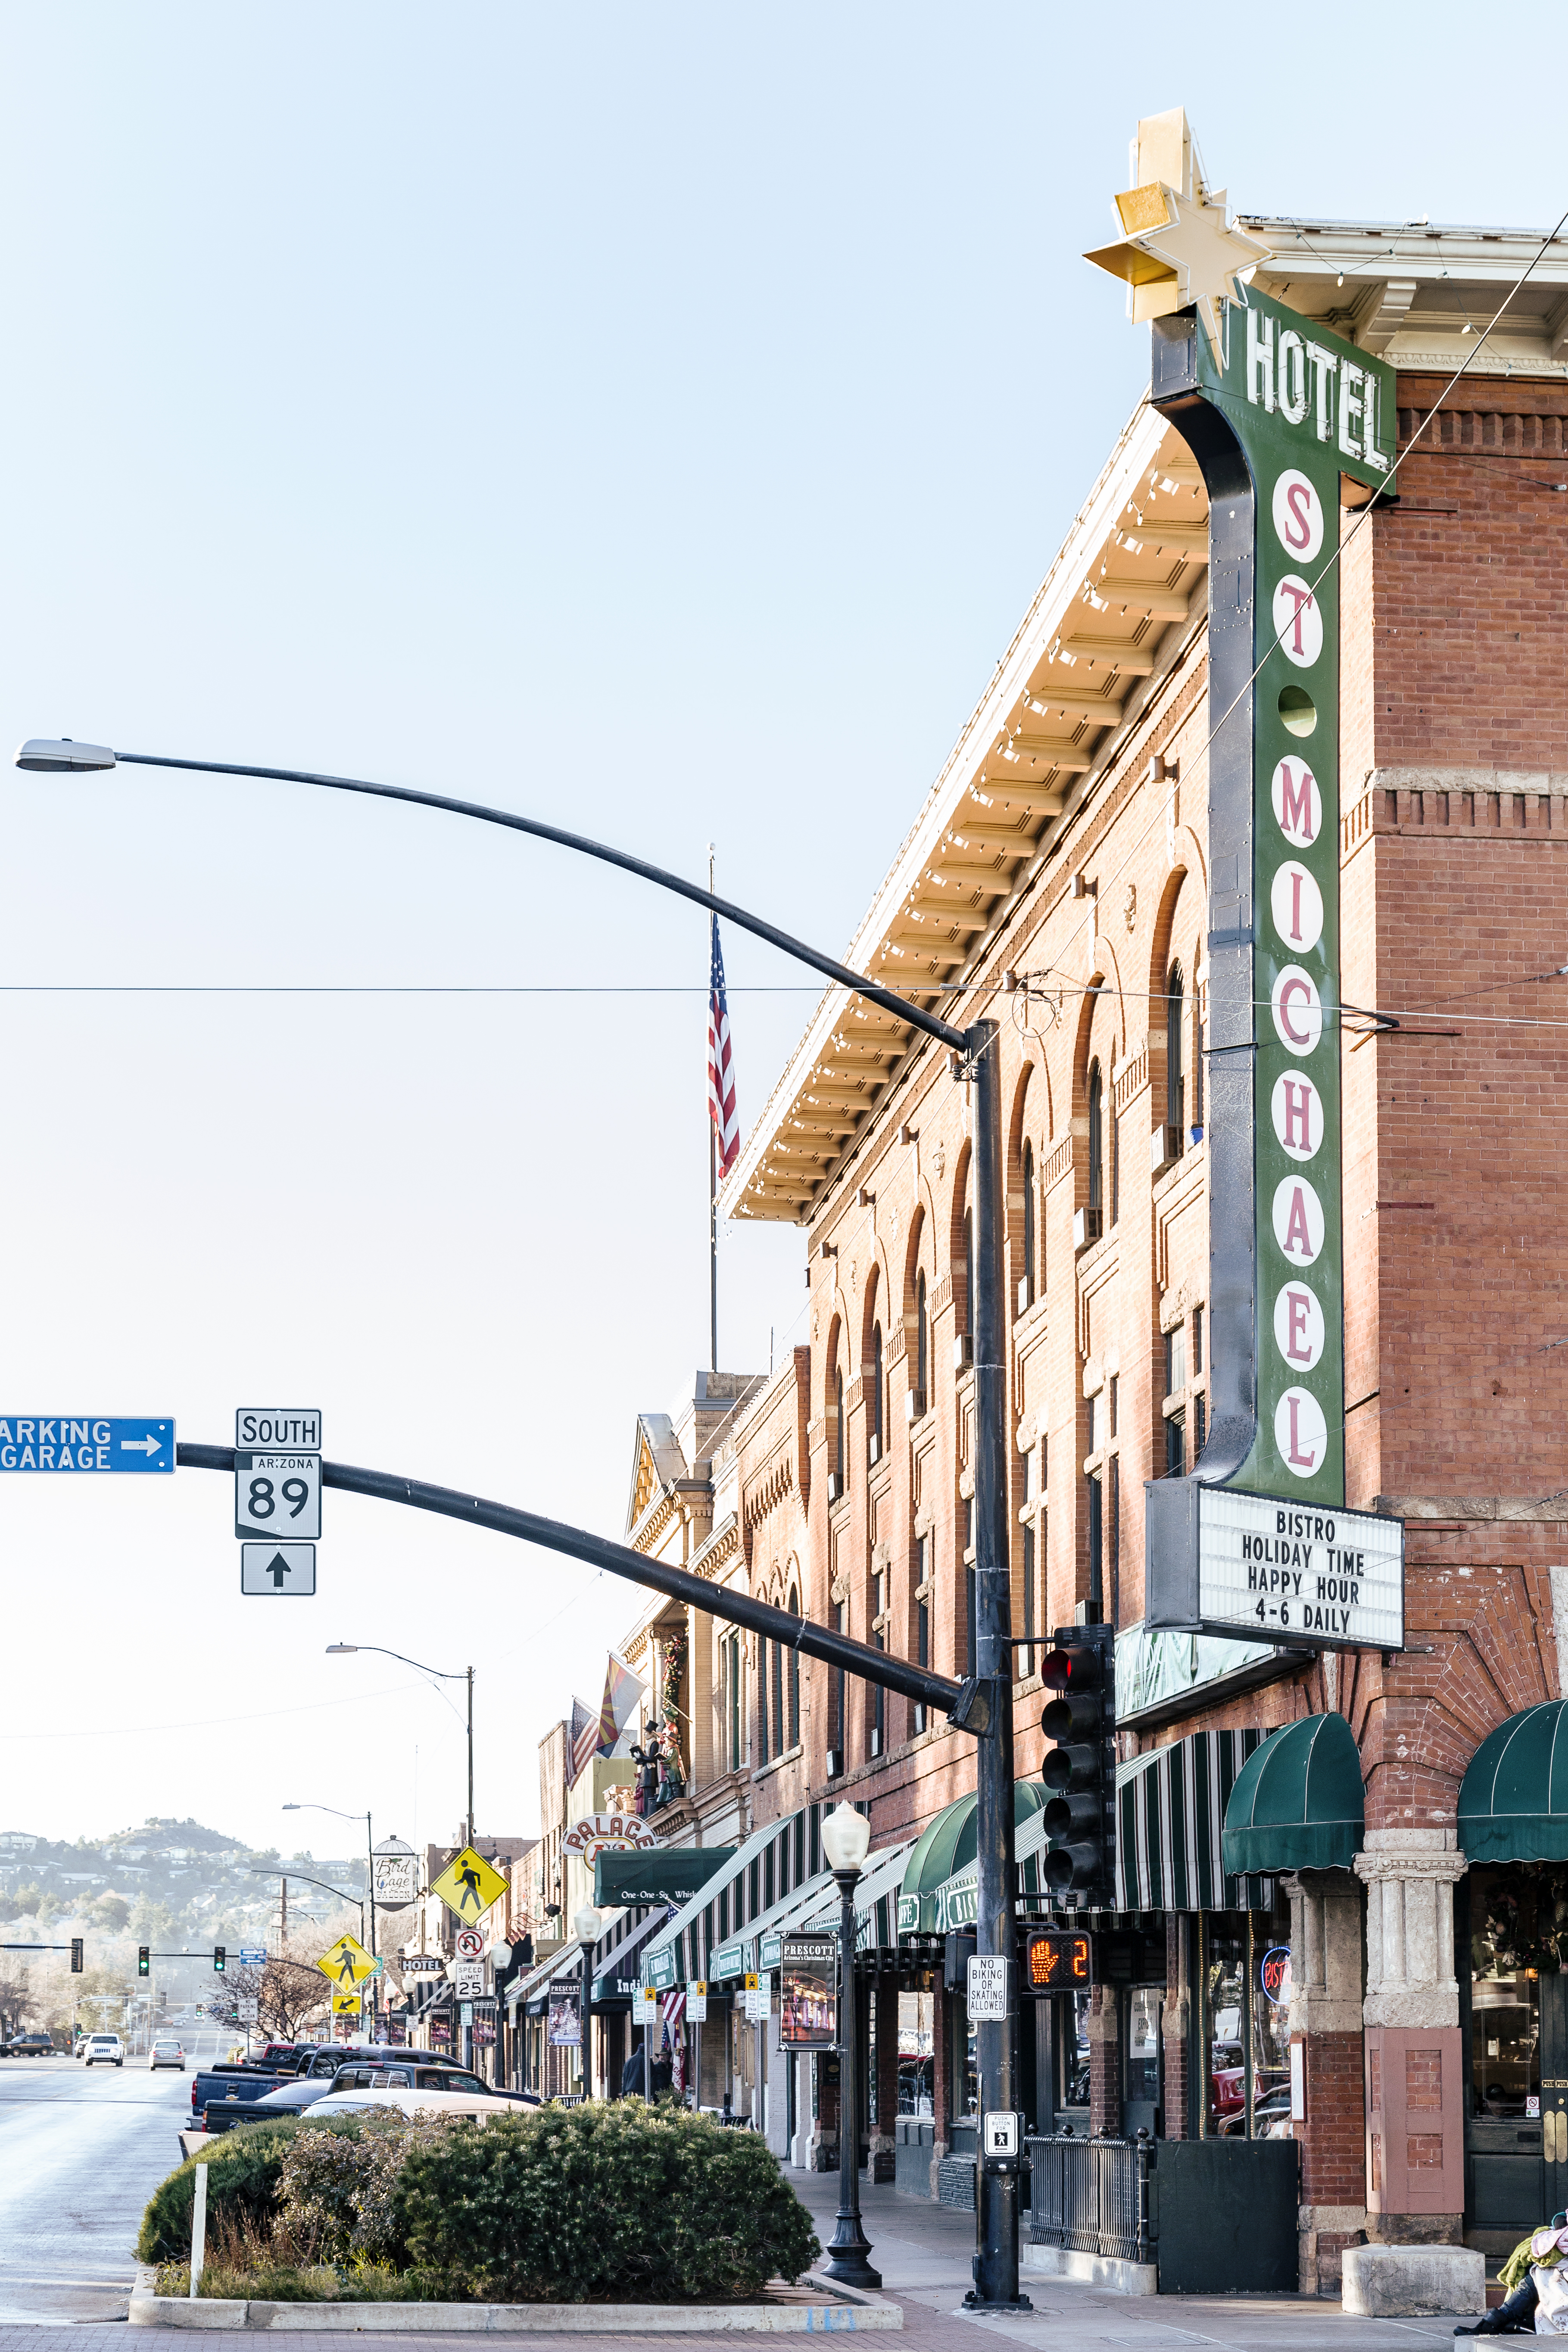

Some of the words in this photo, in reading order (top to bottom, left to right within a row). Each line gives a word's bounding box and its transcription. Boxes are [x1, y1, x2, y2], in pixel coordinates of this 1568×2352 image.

[1247, 307, 1393, 473] HOTEL
[1279, 761, 1315, 1467] MICHAEL
[242, 1416, 315, 1442] SOUTH
[1, 1445, 111, 1469] GARAGE
[258, 1458, 313, 1469] ARIZONA
[248, 1477, 309, 1519] 89
[1277, 1511, 1335, 1542] BISTRO
[1243, 1535, 1312, 1568] HOLIDAY
[1327, 1548, 1364, 1577] TIME
[1249, 1565, 1302, 1595] HAPPY
[1318, 1576, 1359, 1604] HOUR
[1256, 1598, 1289, 1625] 4-6
[1304, 1604, 1350, 1633] DAILY
[566, 1817, 655, 1850] PALACE
[376, 1857, 410, 1874] Bird
[375, 1872, 409, 1891] Cage
[784, 1945, 834, 1955] PRESCOTT
[1073, 1941, 1087, 1976] 2
[402, 1961, 441, 1970] HOTEL
[972, 1970, 1002, 1979] BIKING
[981, 1960, 994, 1969] NO
[459, 1982, 481, 1995] 25
[982, 1980, 992, 1989] OR
[971, 1991, 1003, 2000] SKATING
[971, 2001, 1003, 2010] ALLOWED
